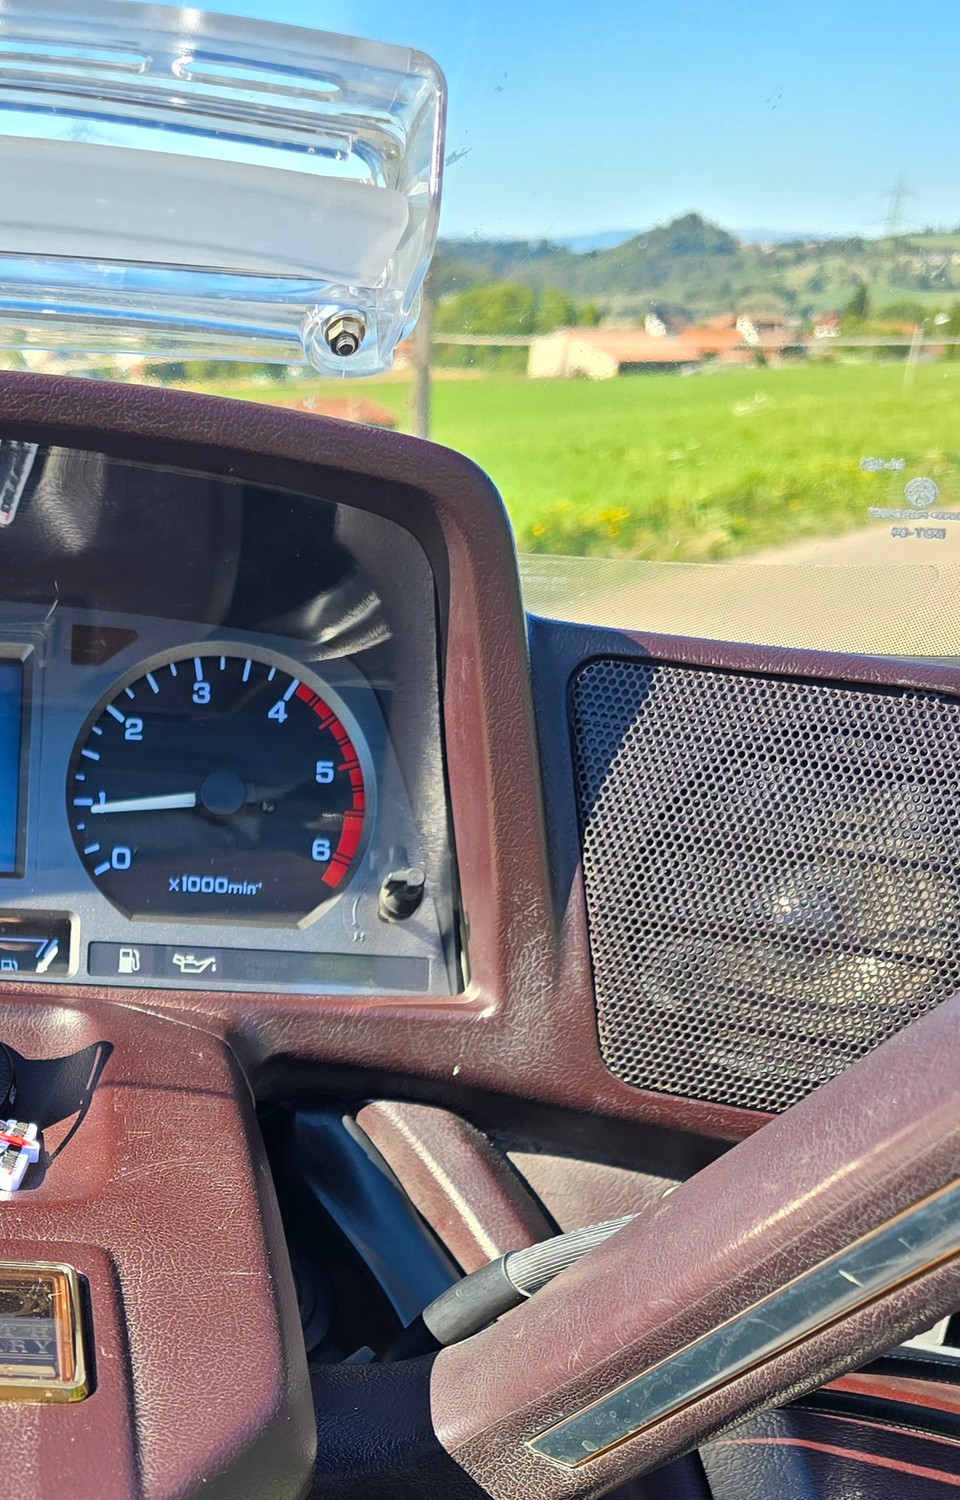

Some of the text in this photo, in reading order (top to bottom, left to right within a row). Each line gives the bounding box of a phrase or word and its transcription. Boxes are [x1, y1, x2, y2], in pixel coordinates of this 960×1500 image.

[192, 682, 211, 705] 3
[268, 701, 288, 724] 4
[125, 718, 144, 741] 2
[315, 761, 335, 785] 5
[111, 846, 132, 871] 0
[311, 838, 332, 862] 6
